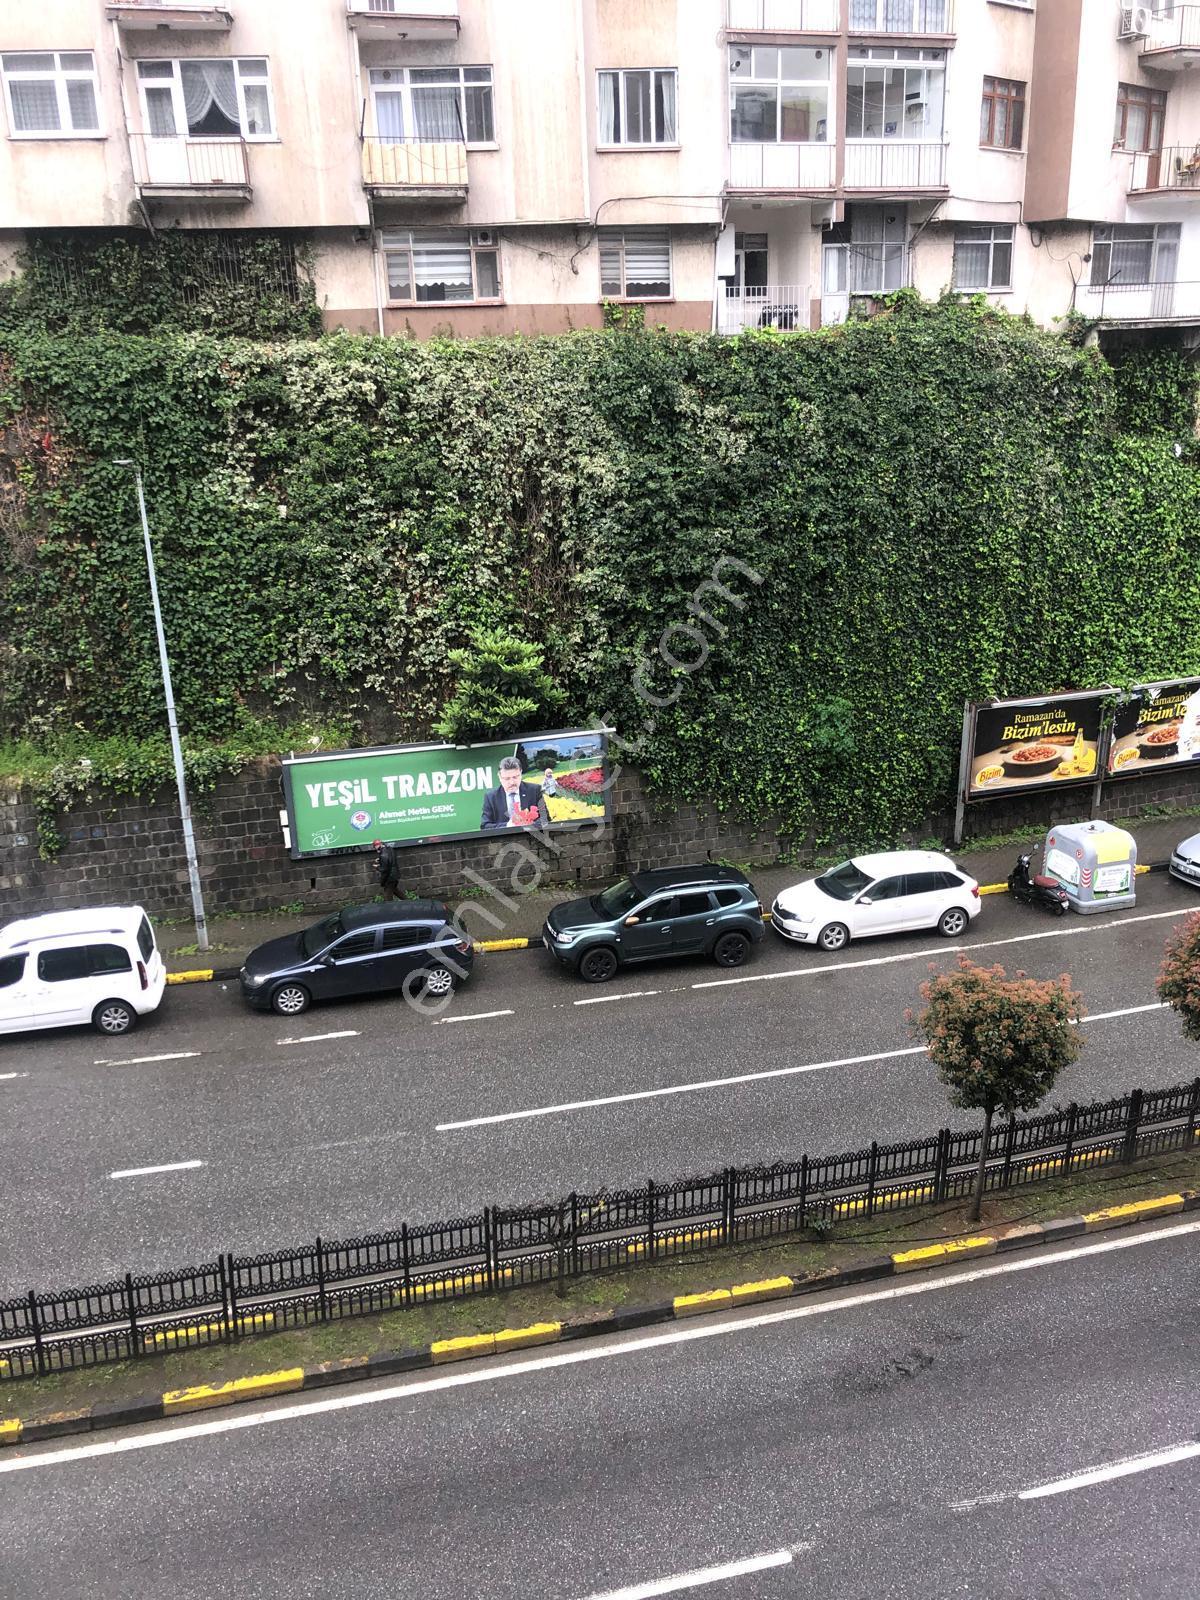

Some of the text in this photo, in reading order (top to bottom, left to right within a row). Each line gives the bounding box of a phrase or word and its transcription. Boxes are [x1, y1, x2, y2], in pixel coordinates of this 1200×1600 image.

[1014, 709, 1066, 723] Ramazan'da
[1001, 719, 1076, 740] Bizim'lesin
[382, 766, 493, 800] TRABZON
[979, 768, 1002, 783] Bizim
[378, 804, 454, 819] Ahmet Metin GENÇ
